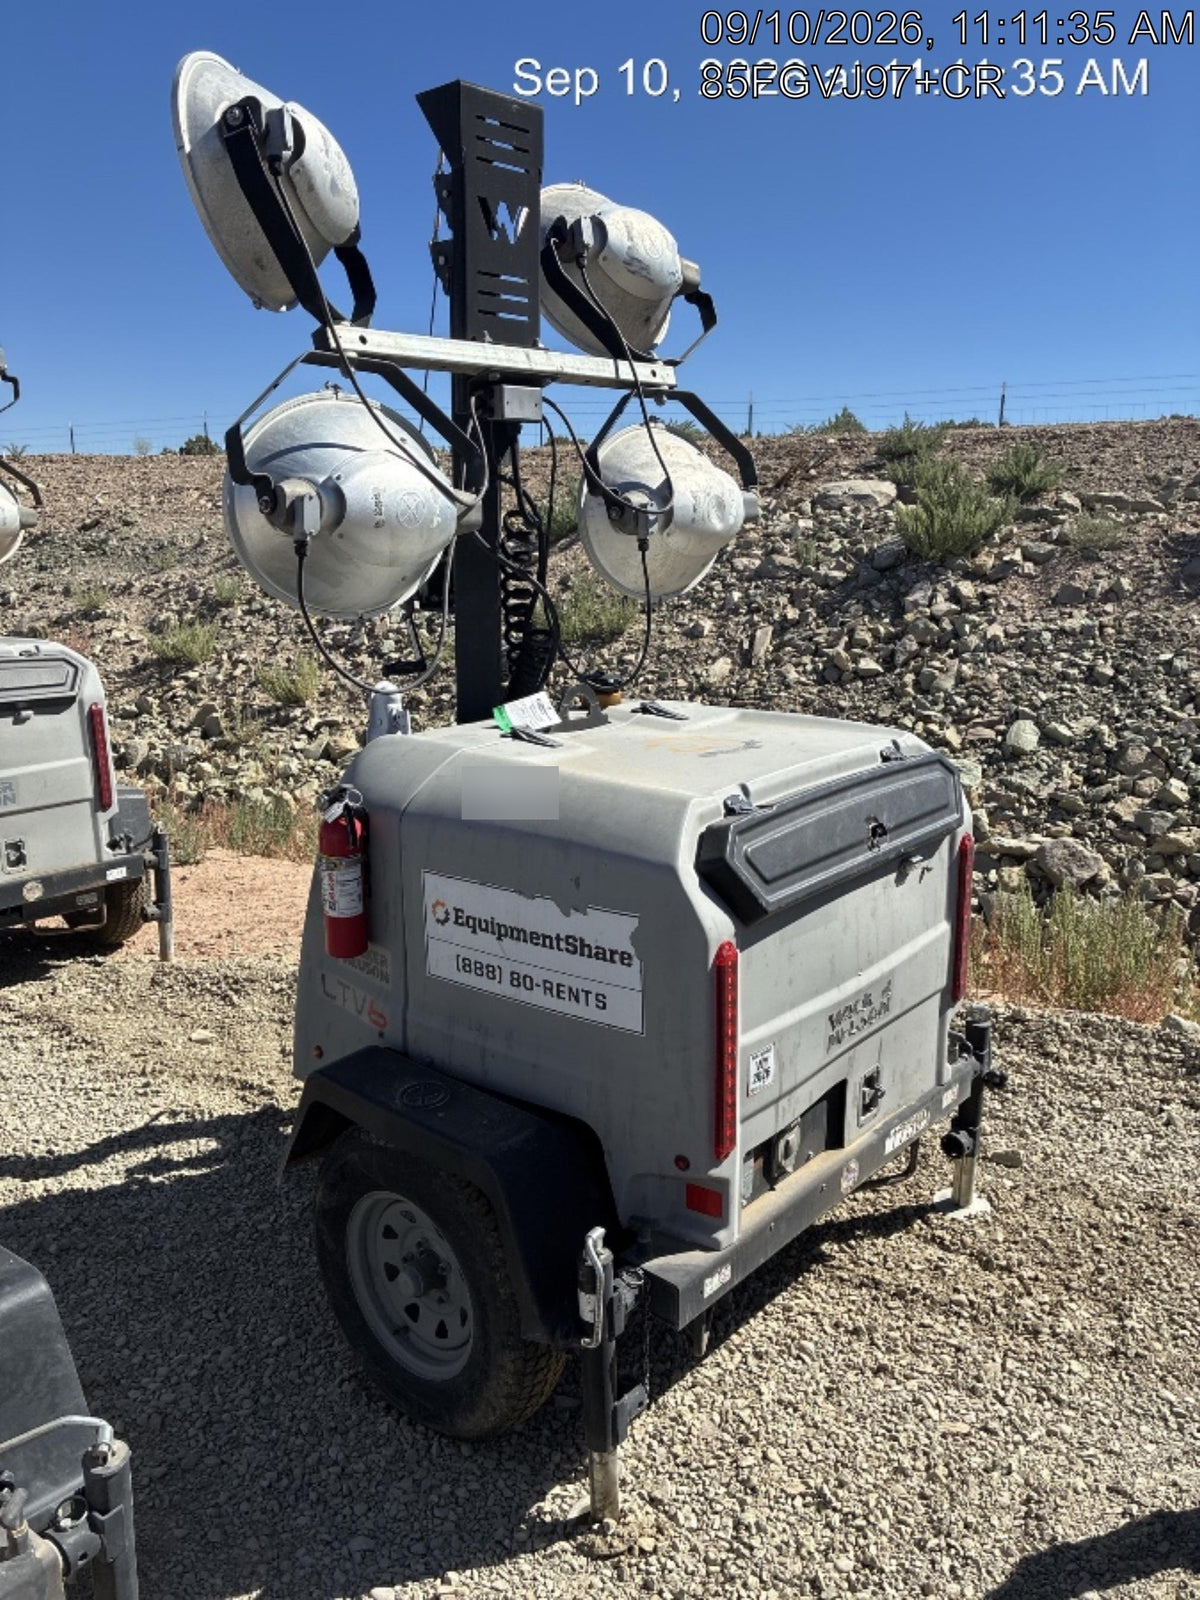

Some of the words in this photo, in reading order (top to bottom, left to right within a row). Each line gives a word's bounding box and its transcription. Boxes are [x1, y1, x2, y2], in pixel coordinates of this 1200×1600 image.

[452, 906, 634, 968] EquipmentShare
[320, 972, 389, 1029] LTV6
[455, 953, 503, 983] (888)
[509, 970, 608, 1011] 80-RENTS
